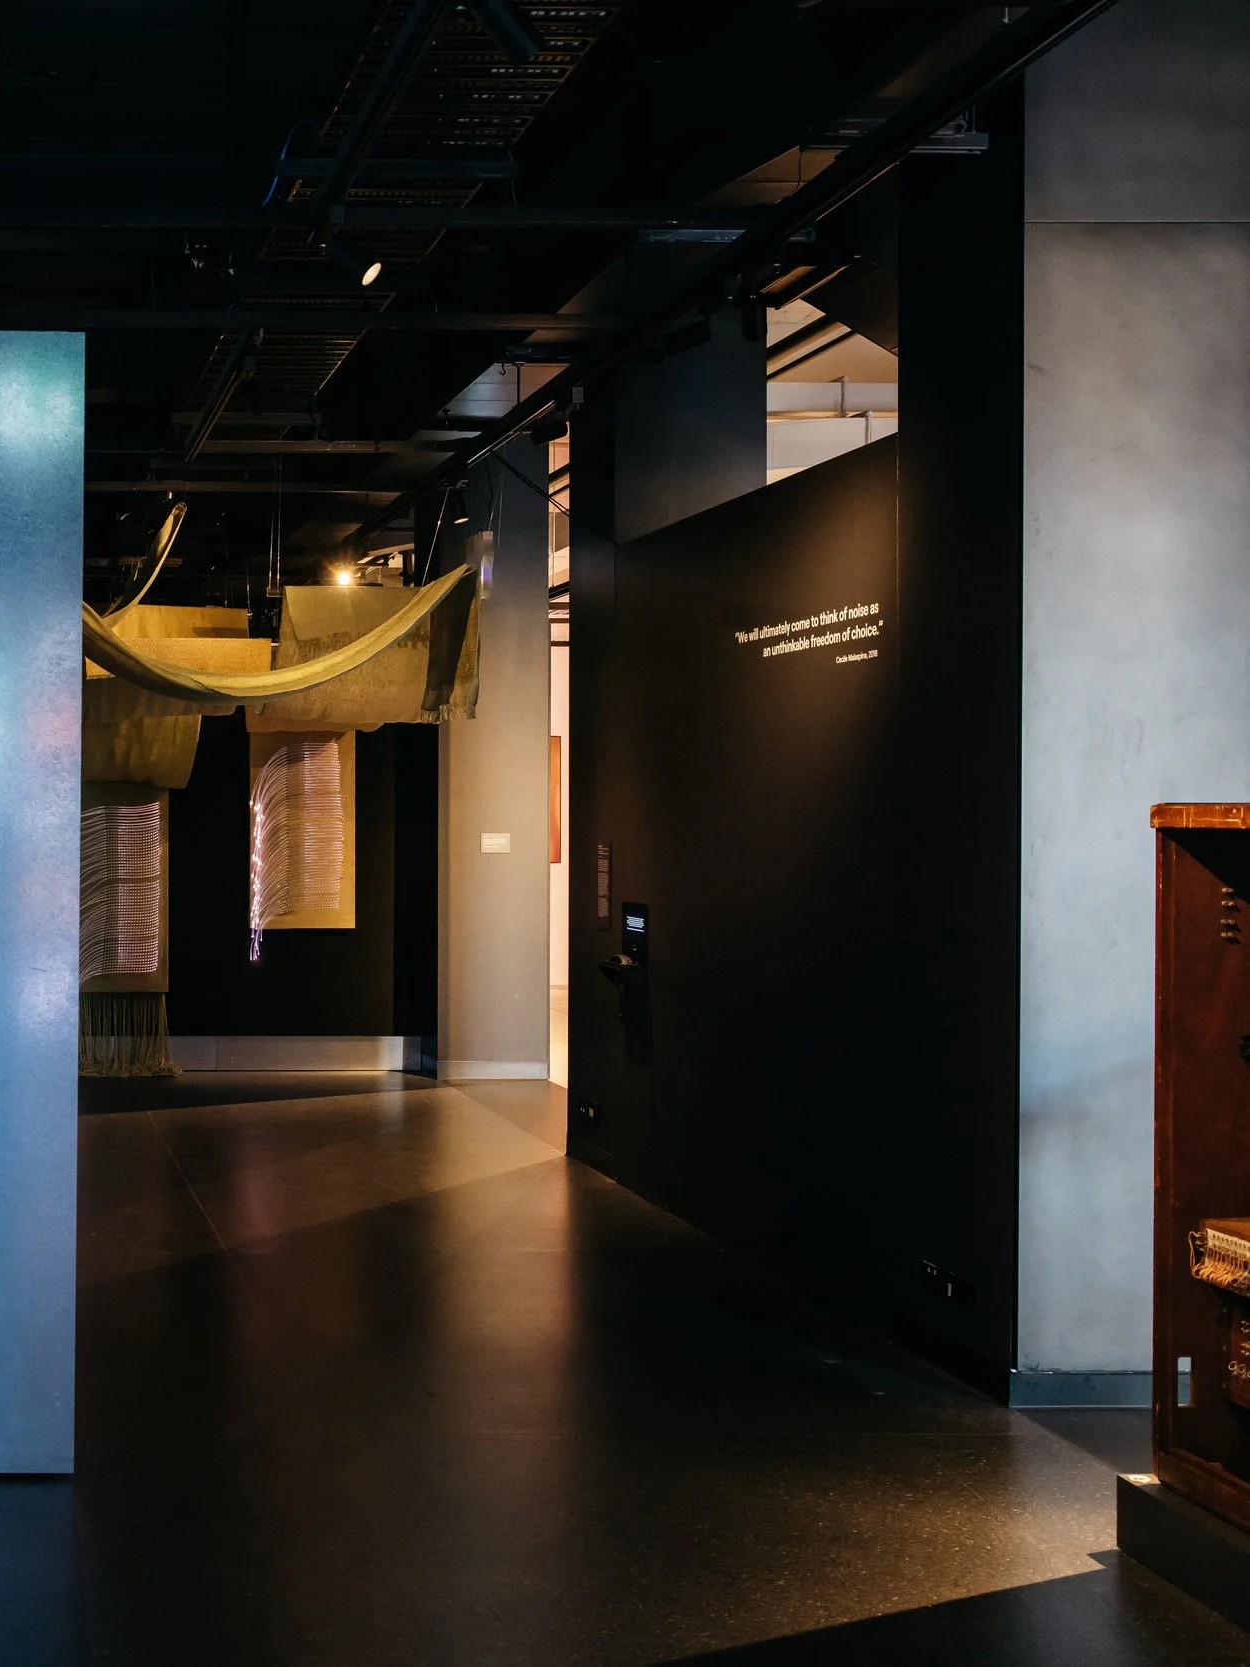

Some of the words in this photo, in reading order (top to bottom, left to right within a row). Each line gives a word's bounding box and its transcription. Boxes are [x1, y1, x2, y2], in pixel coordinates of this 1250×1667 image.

[749, 627, 759, 642] will
[760, 620, 790, 637] ultimately
[791, 618, 810, 632] come
[811, 615, 819, 627] to
[820, 609, 838, 625] think
[839, 605, 848, 621] of
[848, 603, 869, 619] noise
[870, 602, 879, 615] as
[763, 647, 771, 657] an
[771, 635, 810, 656] unthinkable
[810, 631, 841, 648] freedom
[842, 626, 851, 642] of
